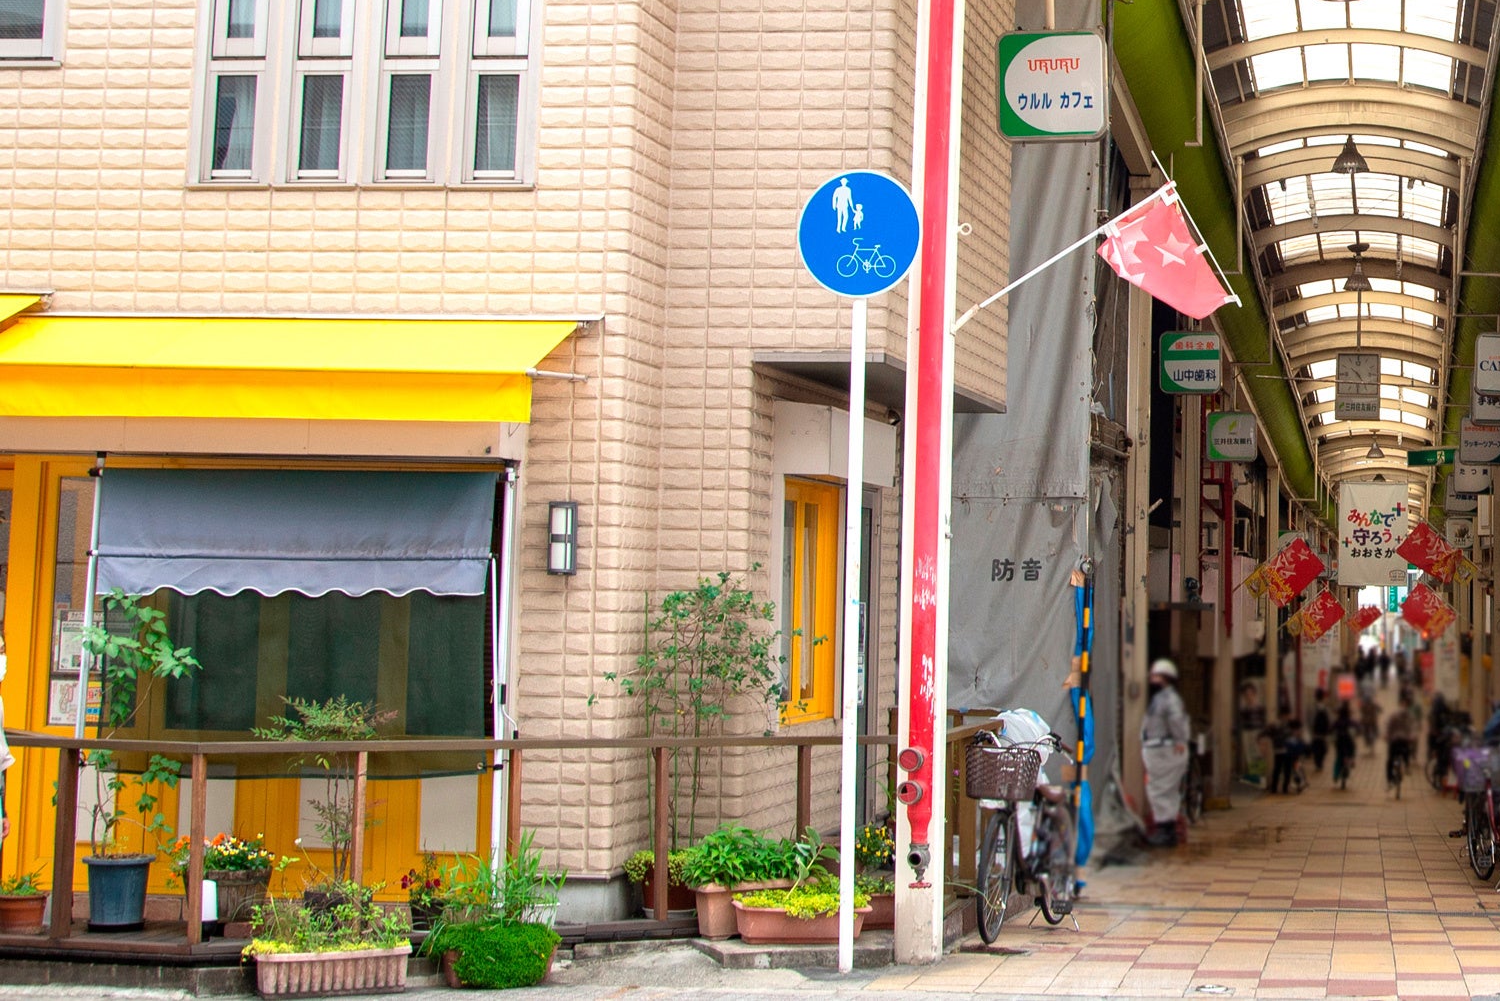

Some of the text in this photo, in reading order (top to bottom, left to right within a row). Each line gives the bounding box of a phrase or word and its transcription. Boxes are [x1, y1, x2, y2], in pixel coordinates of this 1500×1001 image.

[1027, 57, 1080, 74] URURU
[1017, 91, 1094, 111] ウルル カフェ
[1175, 340, 1215, 350] 歯科全般
[1173, 368, 1217, 382] 山中歯科
[1347, 508, 1397, 528] みんなで
[1352, 527, 1393, 547] 守ろう
[1350, 547, 1397, 559] おおさか
[991, 557, 1043, 582] 防音
